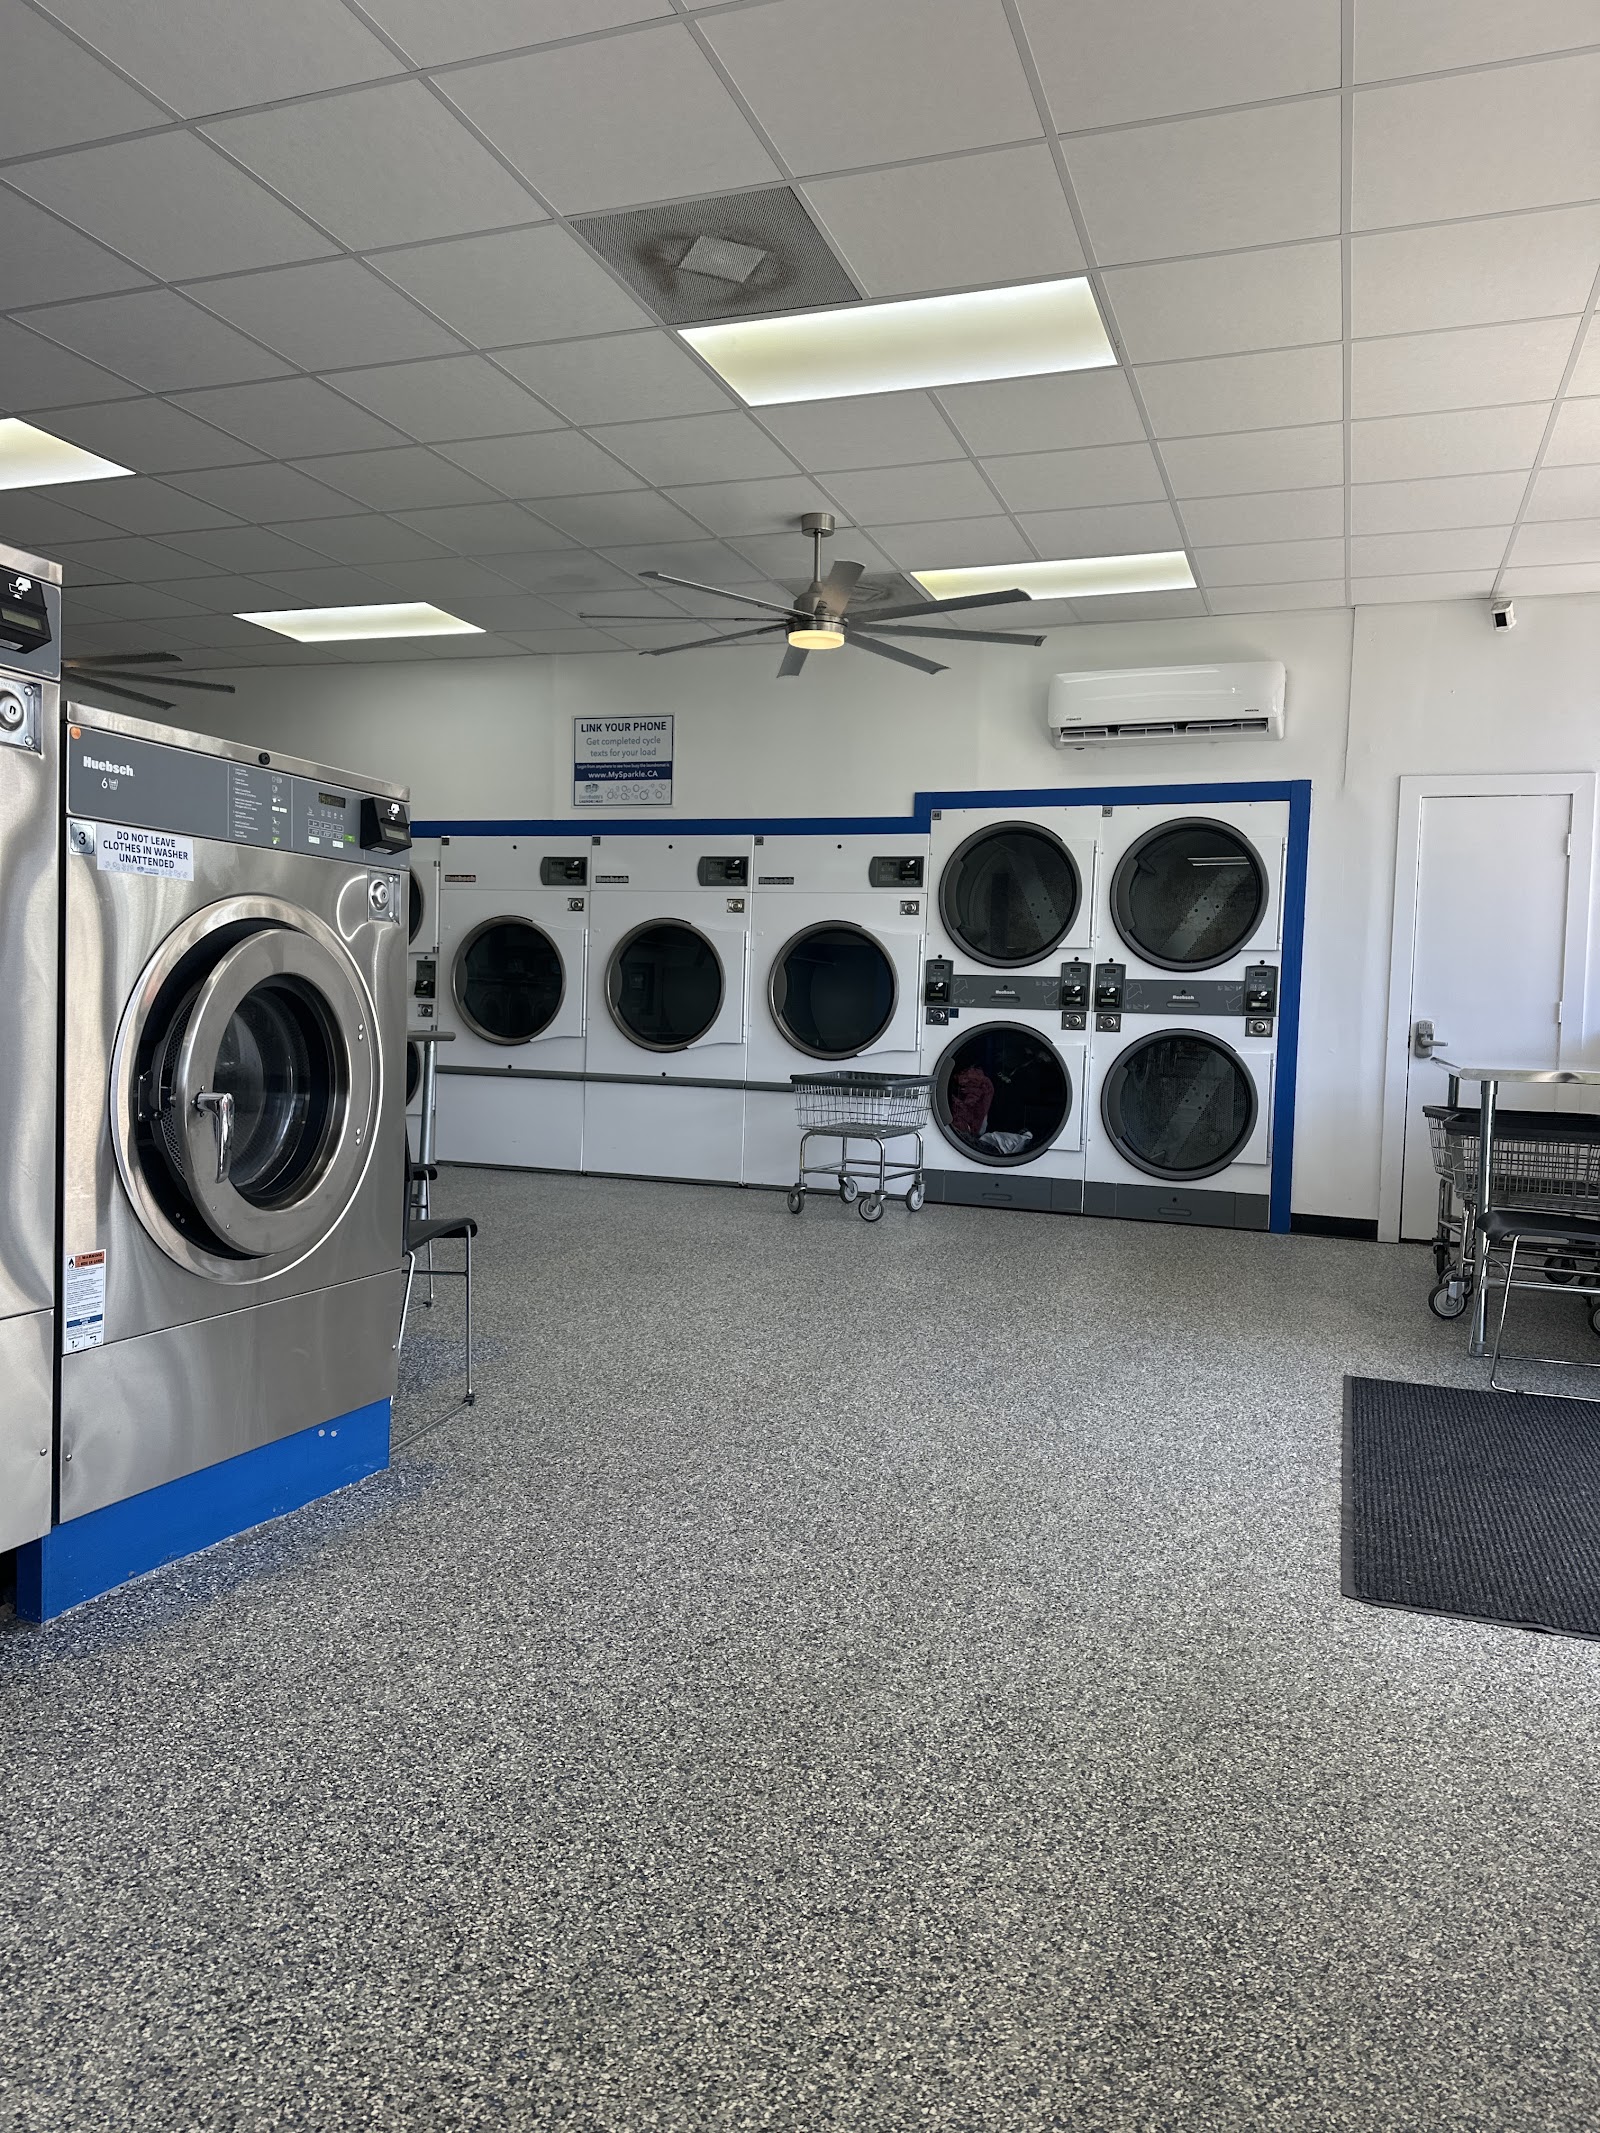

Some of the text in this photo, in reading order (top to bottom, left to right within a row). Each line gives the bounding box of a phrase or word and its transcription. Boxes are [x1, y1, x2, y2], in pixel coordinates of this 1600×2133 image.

[581, 721, 667, 732] LINK YOUR PHONE
[586, 736, 661, 747] Get completed cycle
[590, 747, 657, 758] texts for your load
[83, 755, 134, 777] Huebsch
[588, 770, 658, 779] www.MySparkle.CA
[101, 777, 108, 789] 6
[78, 831, 86, 846] 3
[116, 830, 176, 848] DO NOT LEAVE
[103, 840, 189, 860] CLOTHES IN WASHER
[119, 853, 175, 869] UNATTENDED
